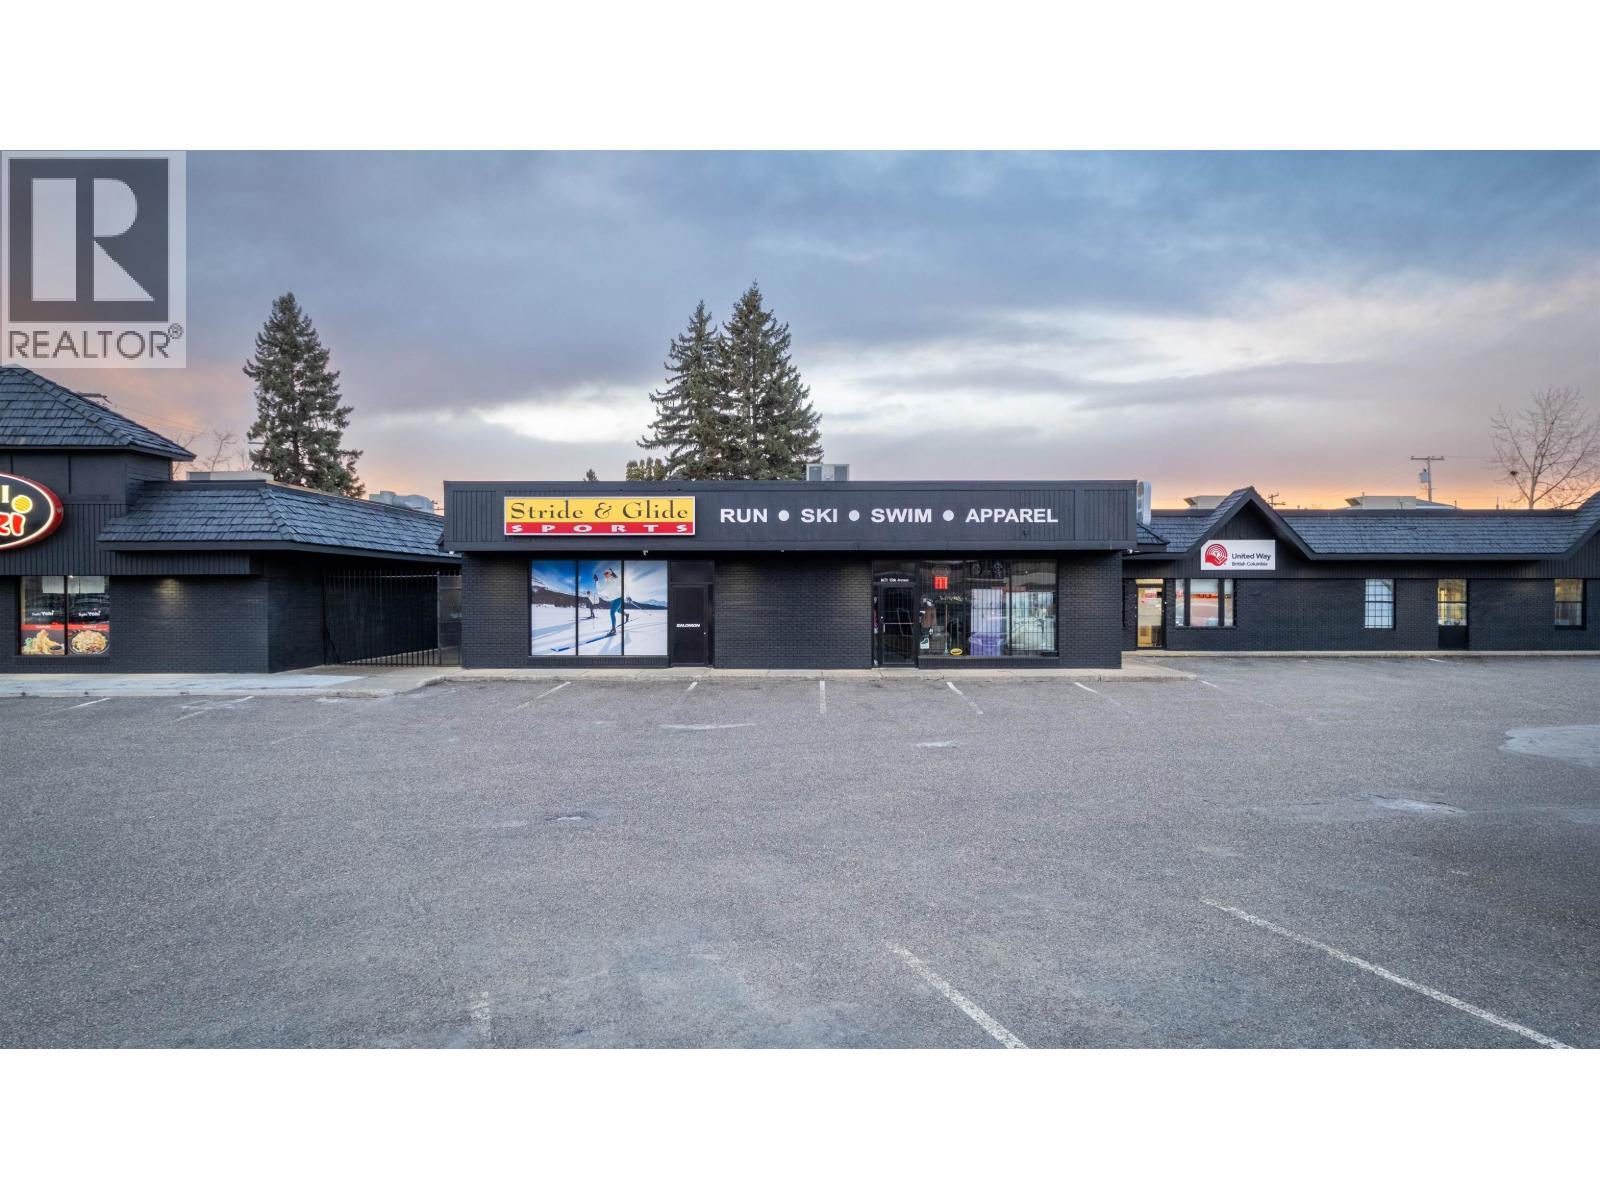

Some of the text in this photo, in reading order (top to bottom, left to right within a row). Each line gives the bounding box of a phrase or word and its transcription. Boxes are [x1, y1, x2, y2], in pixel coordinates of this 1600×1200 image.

[511, 500, 688, 519] Stride & Glide
[720, 508, 1059, 523] RUN SKI SWIM APPAREL
[511, 524, 688, 533] SPORTS
[1256, 553, 1272, 561] Way
